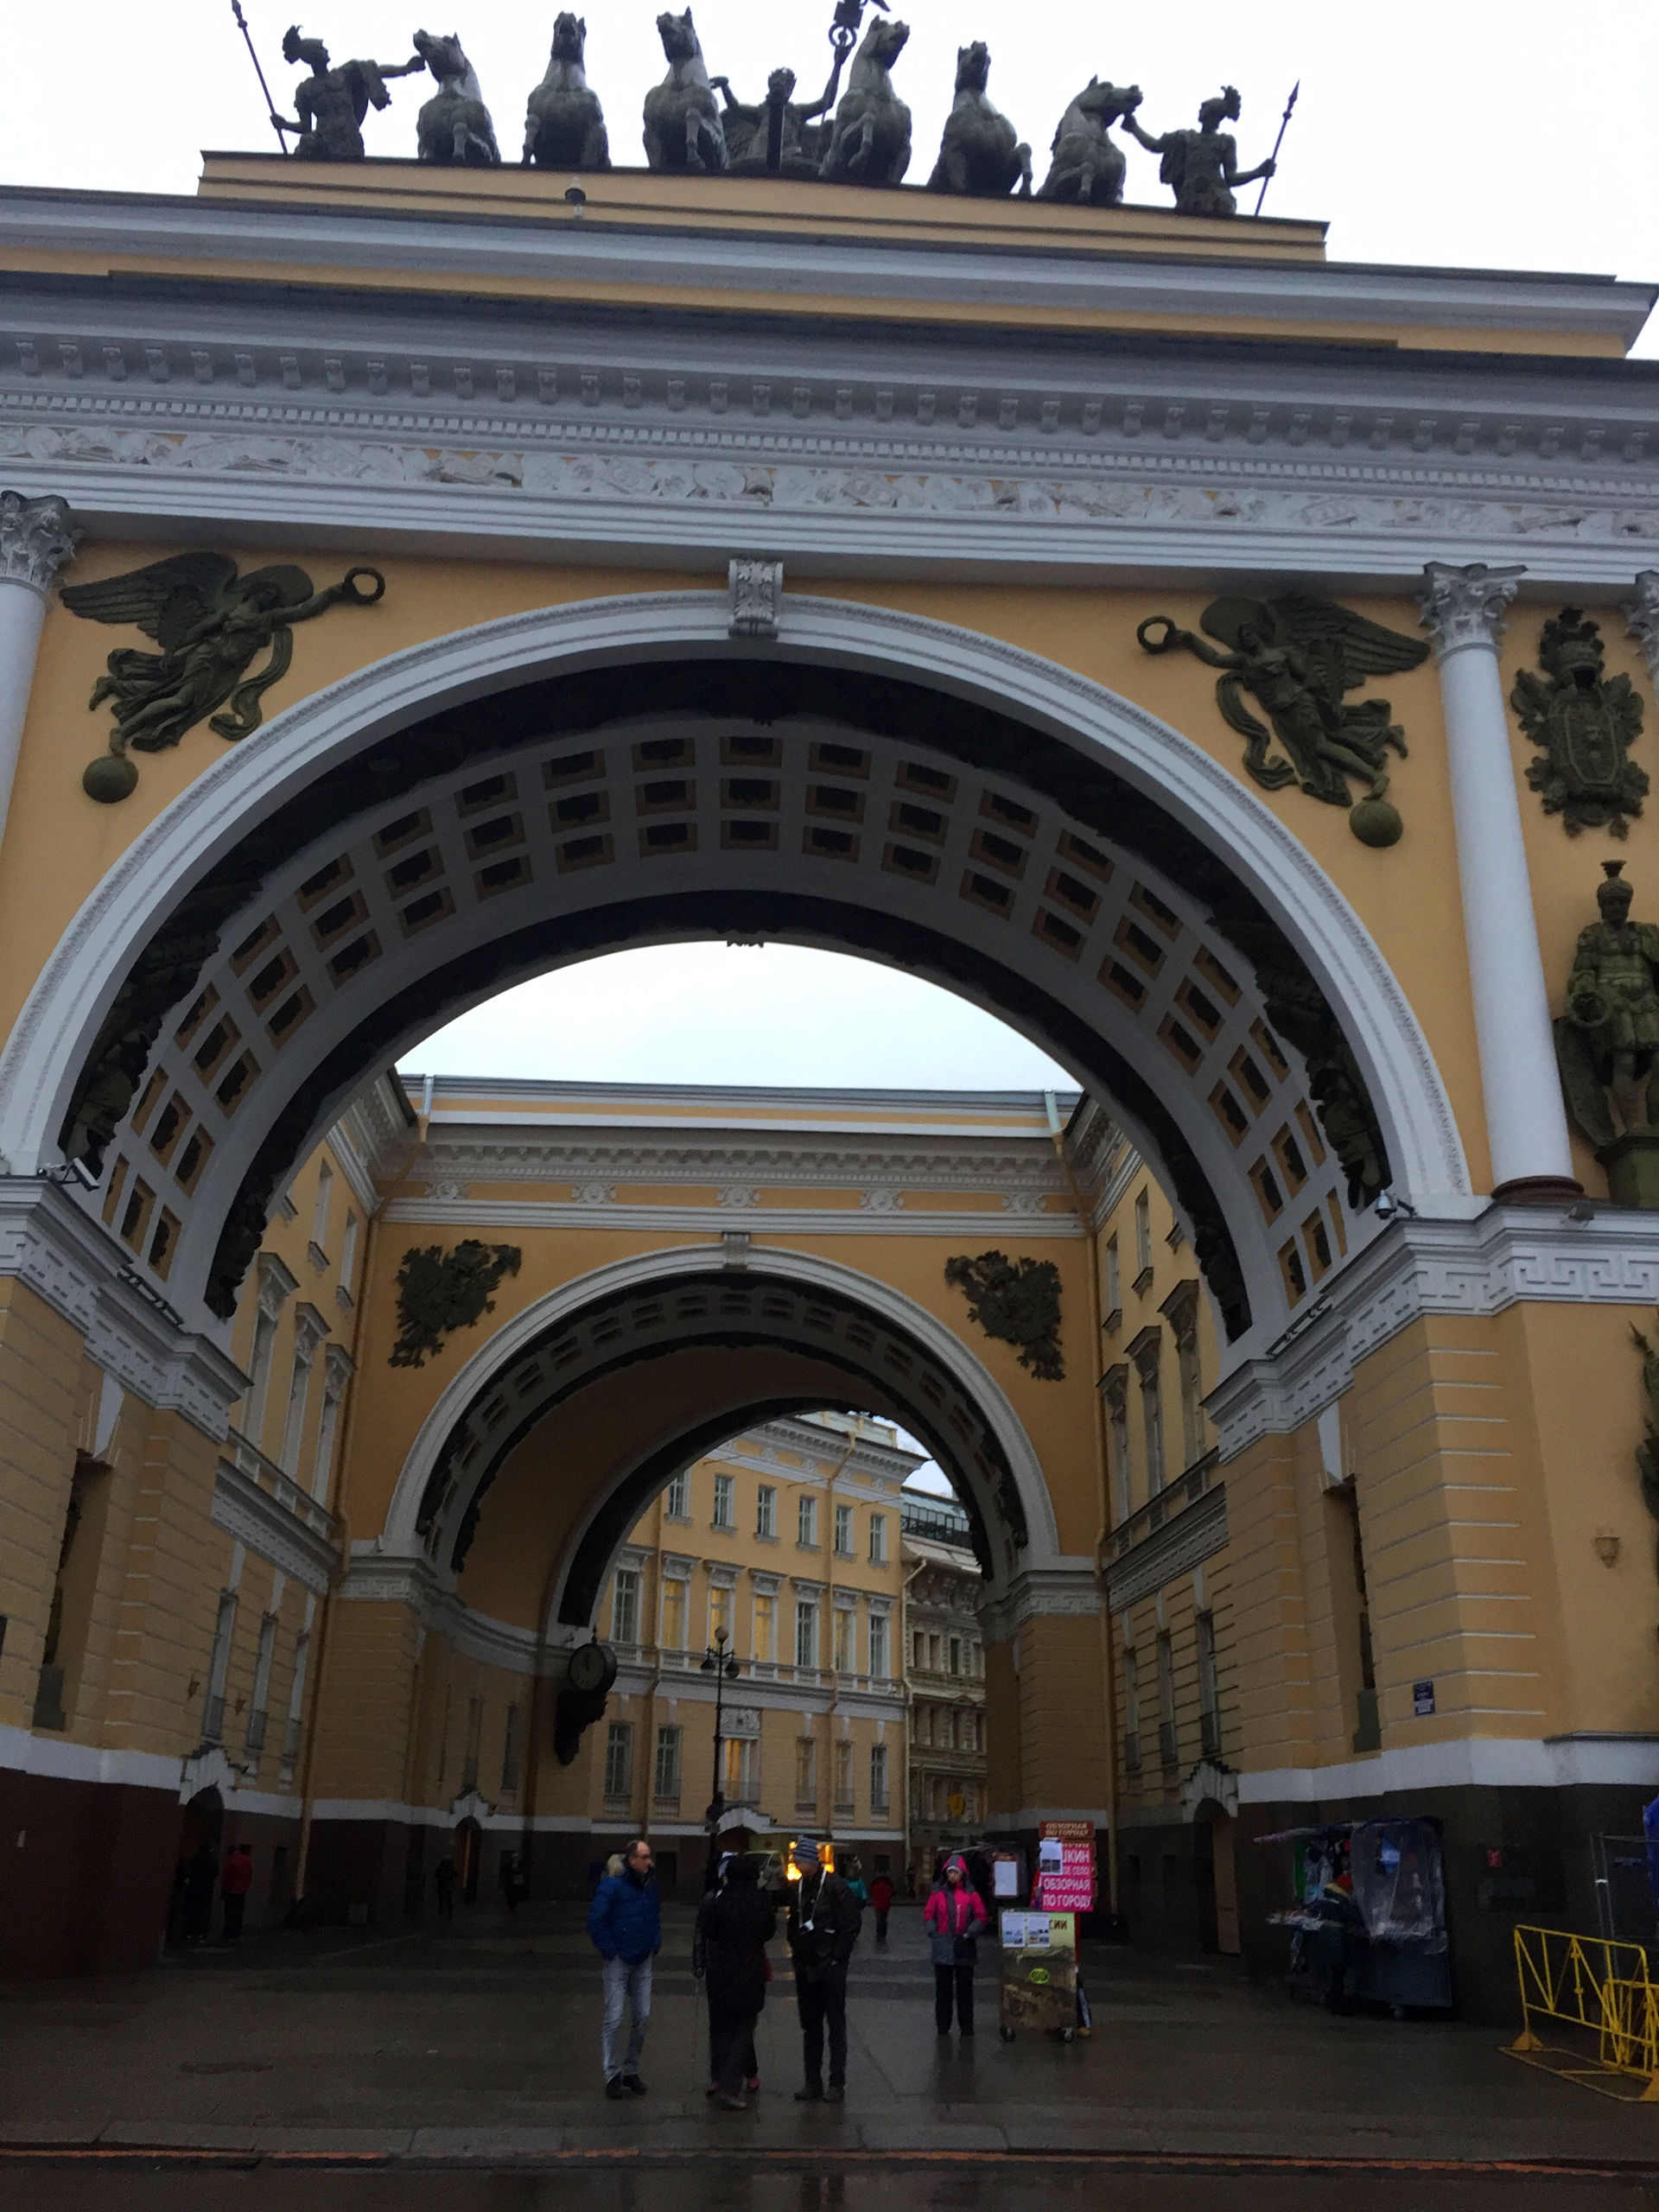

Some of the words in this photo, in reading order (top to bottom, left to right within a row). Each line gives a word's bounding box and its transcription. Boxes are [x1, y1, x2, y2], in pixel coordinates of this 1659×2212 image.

[1043, 1878, 1090, 1891] ОБЗОРНАЯ
[1043, 1894, 1056, 1907] ПО
[1058, 1894, 1092, 1910] ГОРОДУ
